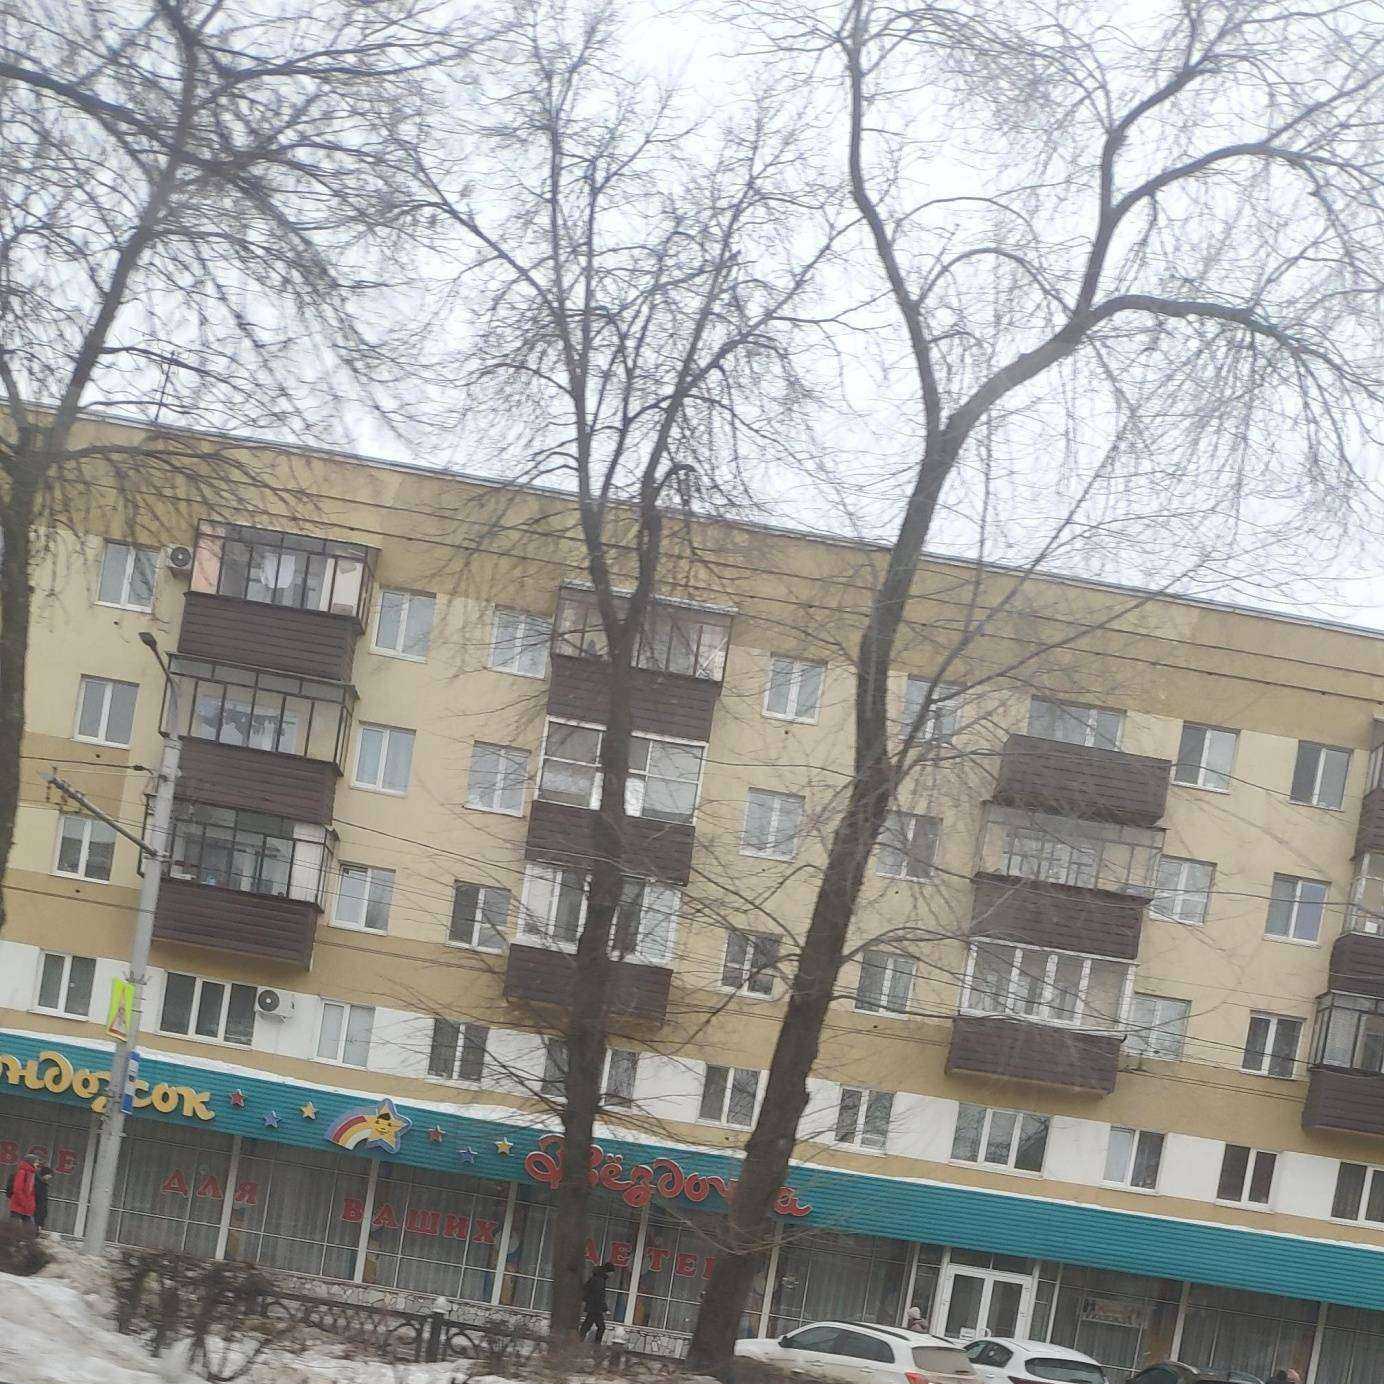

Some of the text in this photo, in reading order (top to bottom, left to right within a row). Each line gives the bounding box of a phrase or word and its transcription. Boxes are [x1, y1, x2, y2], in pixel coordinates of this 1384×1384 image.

[160, 1168, 257, 1207] ДЛЯ
[340, 1198, 499, 1245] ВАШИХ
[524, 1133, 813, 1217] Зёздоча
